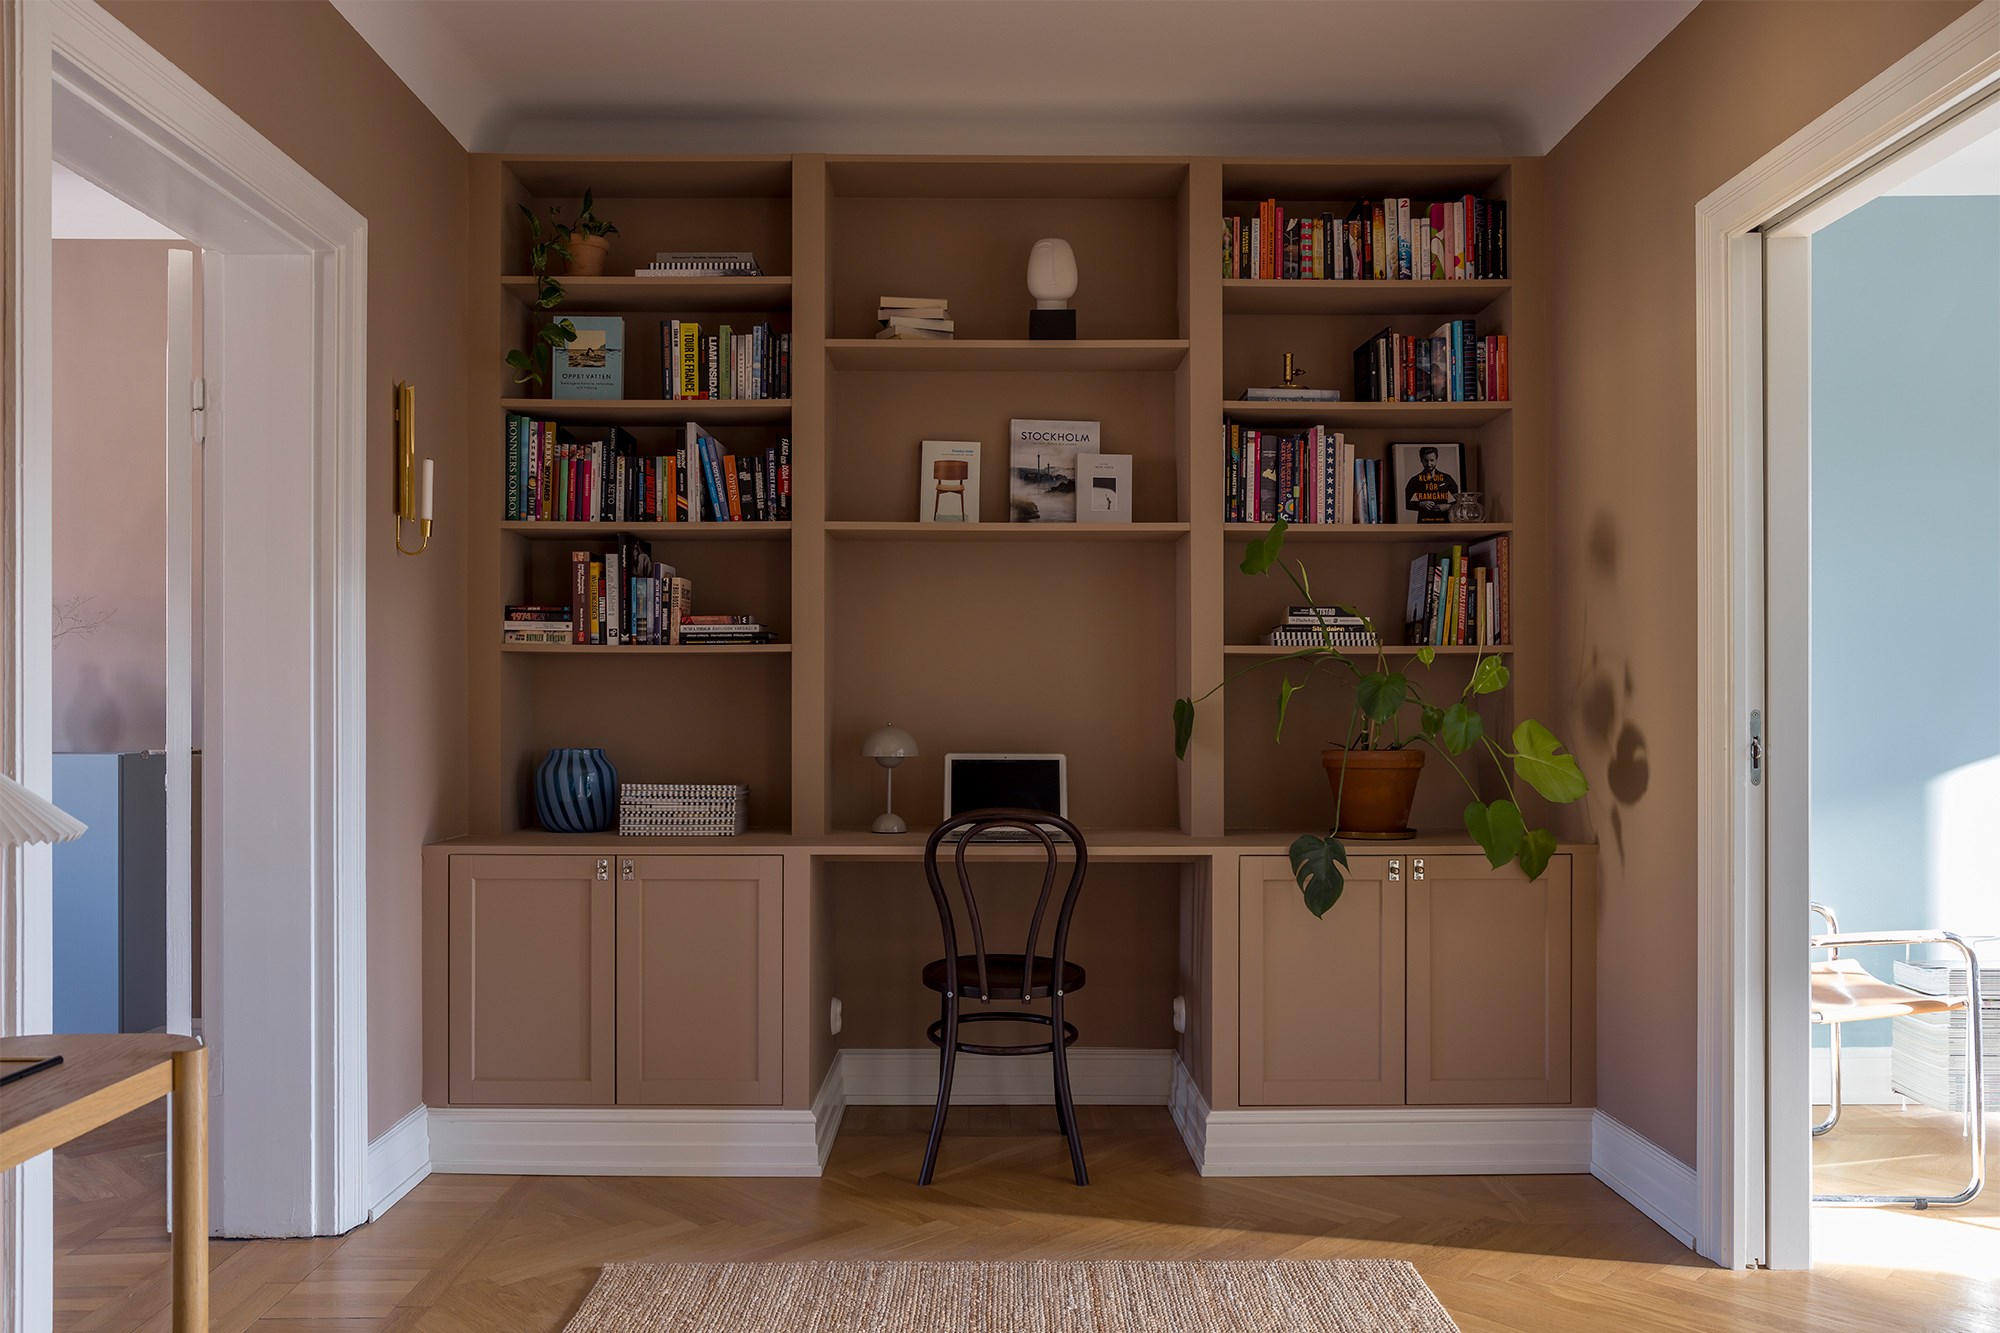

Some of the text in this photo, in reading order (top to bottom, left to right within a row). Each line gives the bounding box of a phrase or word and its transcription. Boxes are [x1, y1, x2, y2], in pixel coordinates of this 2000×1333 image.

[684, 333, 695, 392] TOUR DE FRANCE
[1021, 431, 1090, 442] STOCKHOLM
[508, 421, 518, 517] BONNIERS KOKBOK
[1433, 474, 1444, 482] DIG
